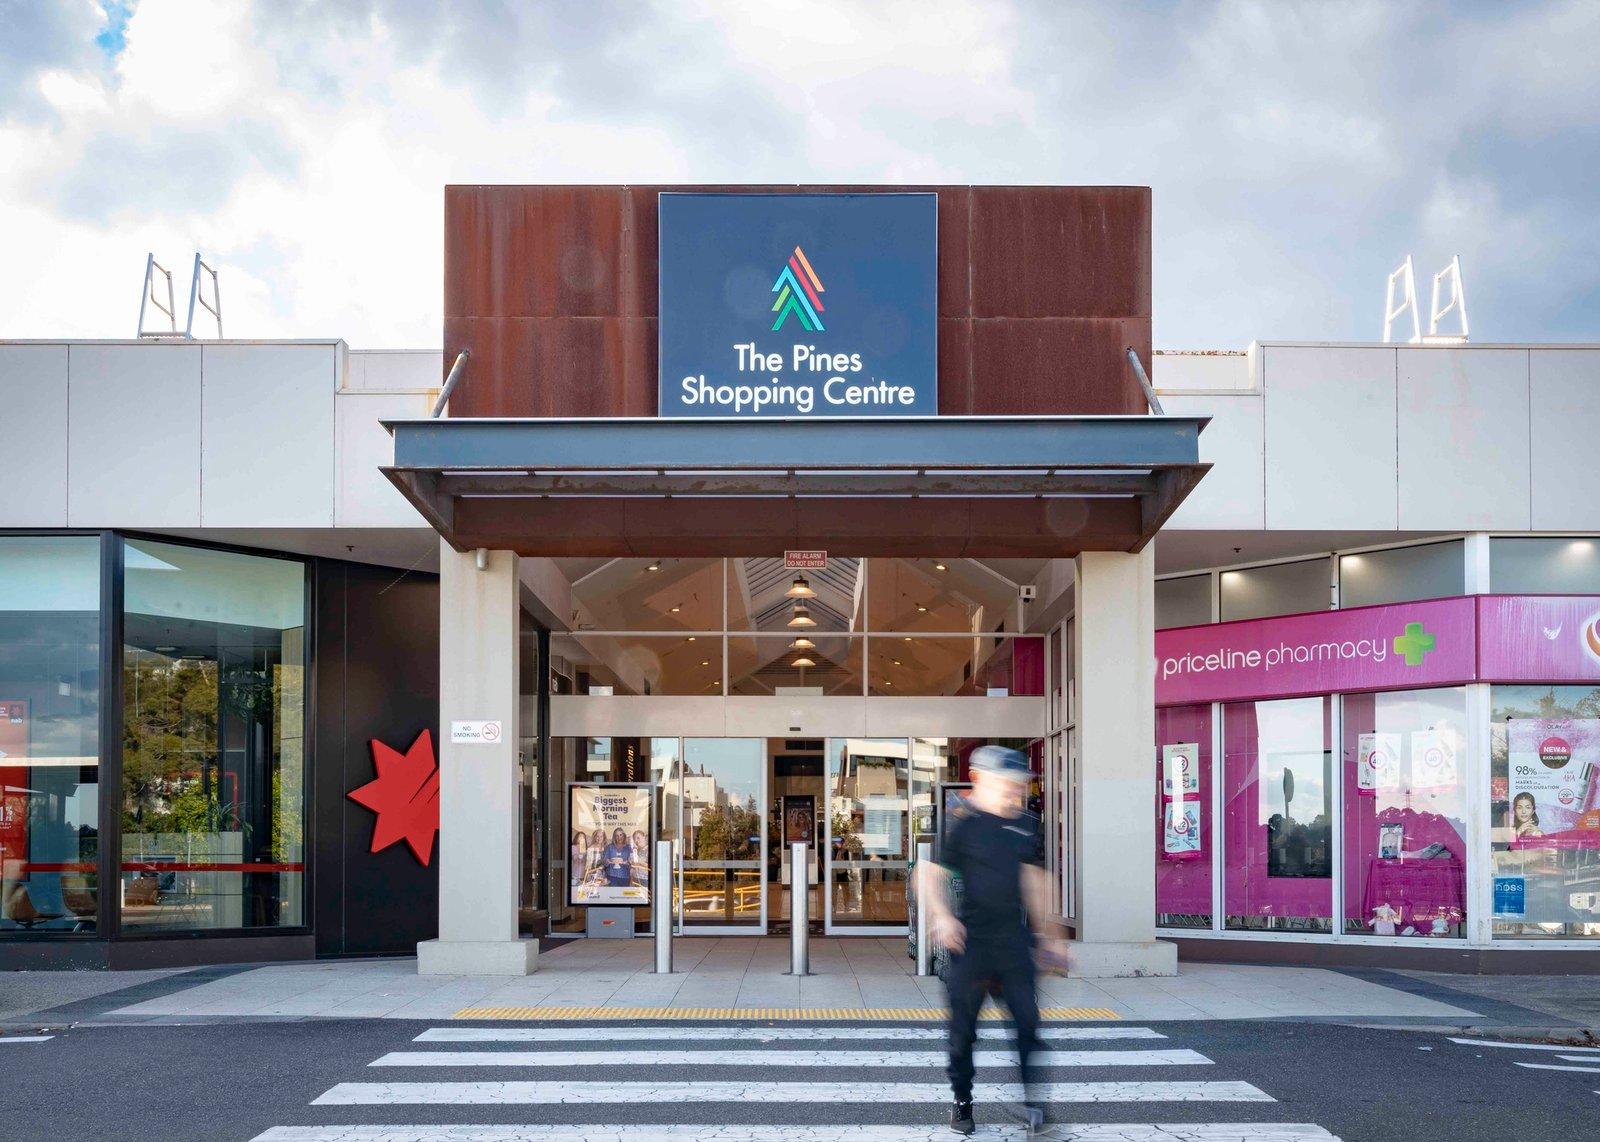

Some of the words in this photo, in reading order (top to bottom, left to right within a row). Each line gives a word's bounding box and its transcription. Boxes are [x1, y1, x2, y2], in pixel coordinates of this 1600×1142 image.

[733, 342, 783, 371] The
[793, 344, 862, 372] Pines
[681, 374, 814, 413] Shopping
[823, 376, 915, 405] Centre
[1163, 648, 1261, 681] priceline
[1265, 638, 1387, 672] pharmacy
[1515, 765, 1538, 776] 98%
[594, 796, 627, 806] Biggest
[603, 812, 618, 820] Tea
